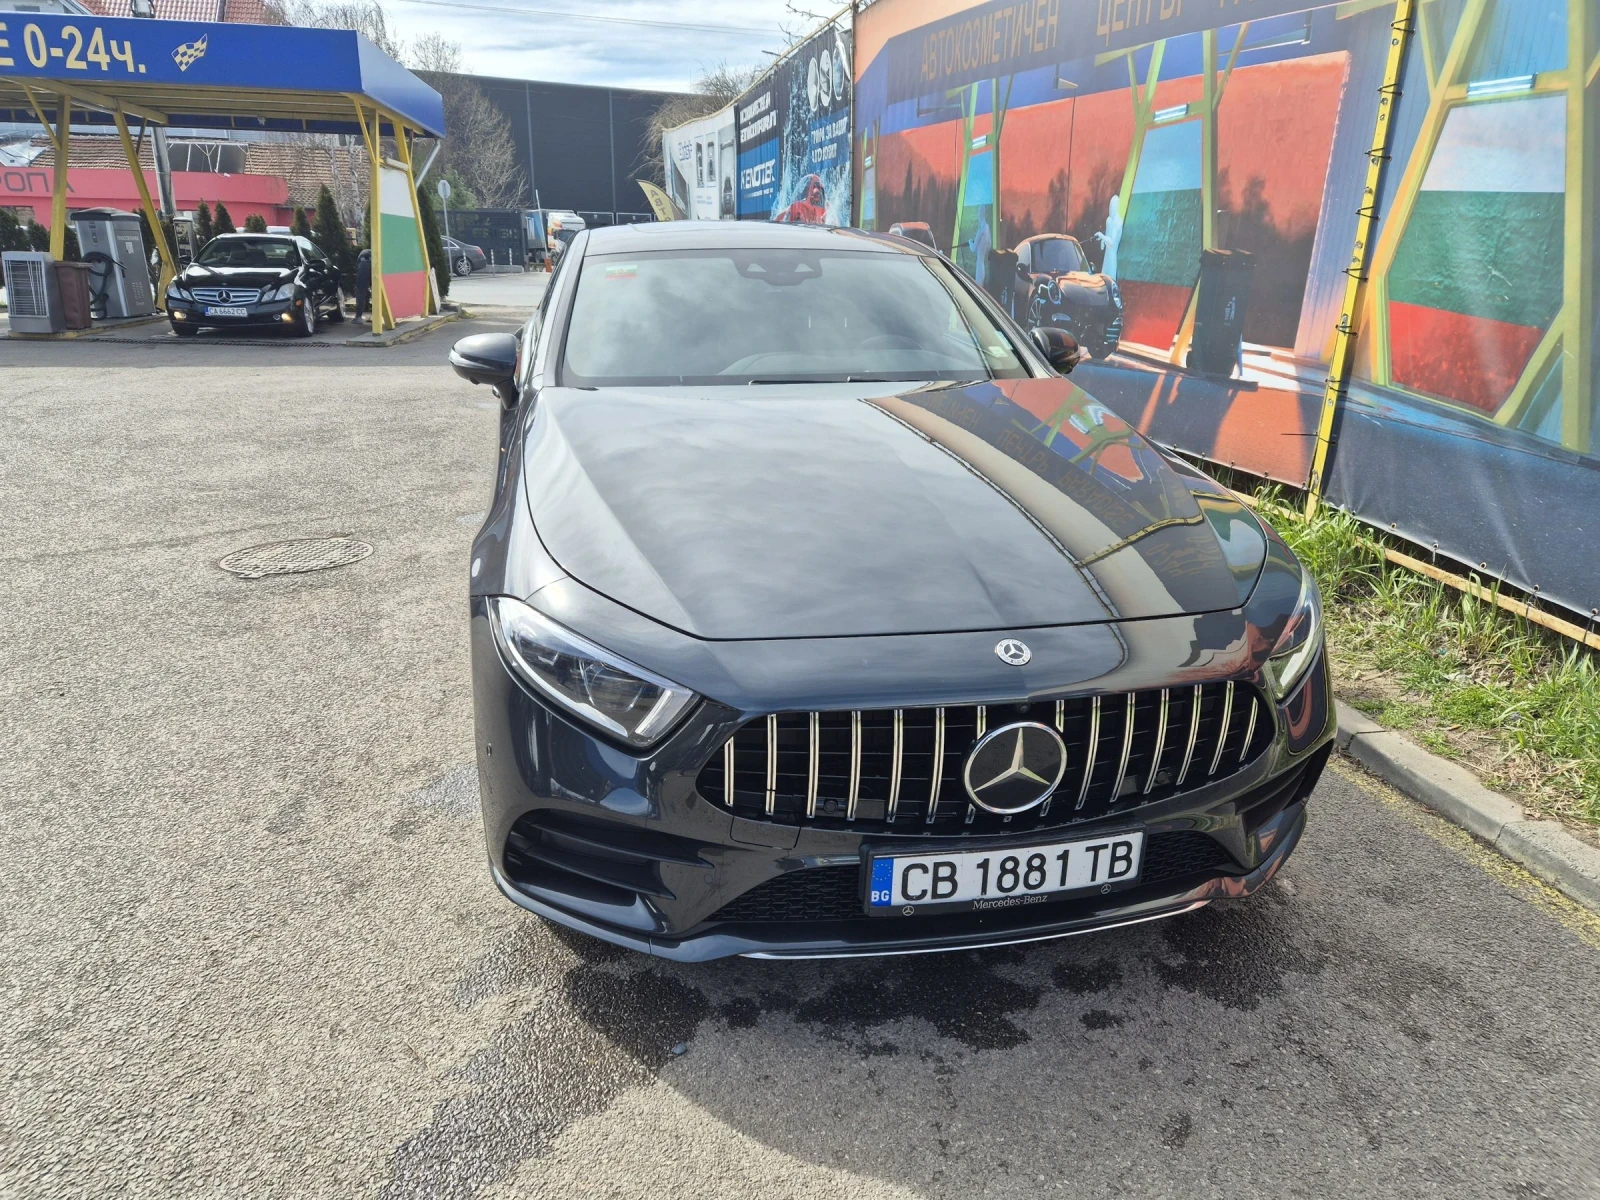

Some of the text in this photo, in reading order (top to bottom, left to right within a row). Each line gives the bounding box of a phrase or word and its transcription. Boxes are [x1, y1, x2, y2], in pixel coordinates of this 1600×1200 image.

[23, 23, 147, 73] 0-24ч.
[0, 171, 75, 192] ОП
[901, 840, 1134, 901] CB 1881 TB
[871, 890, 890, 902] BG
[972, 894, 1048, 910] Mercedes-Benz
